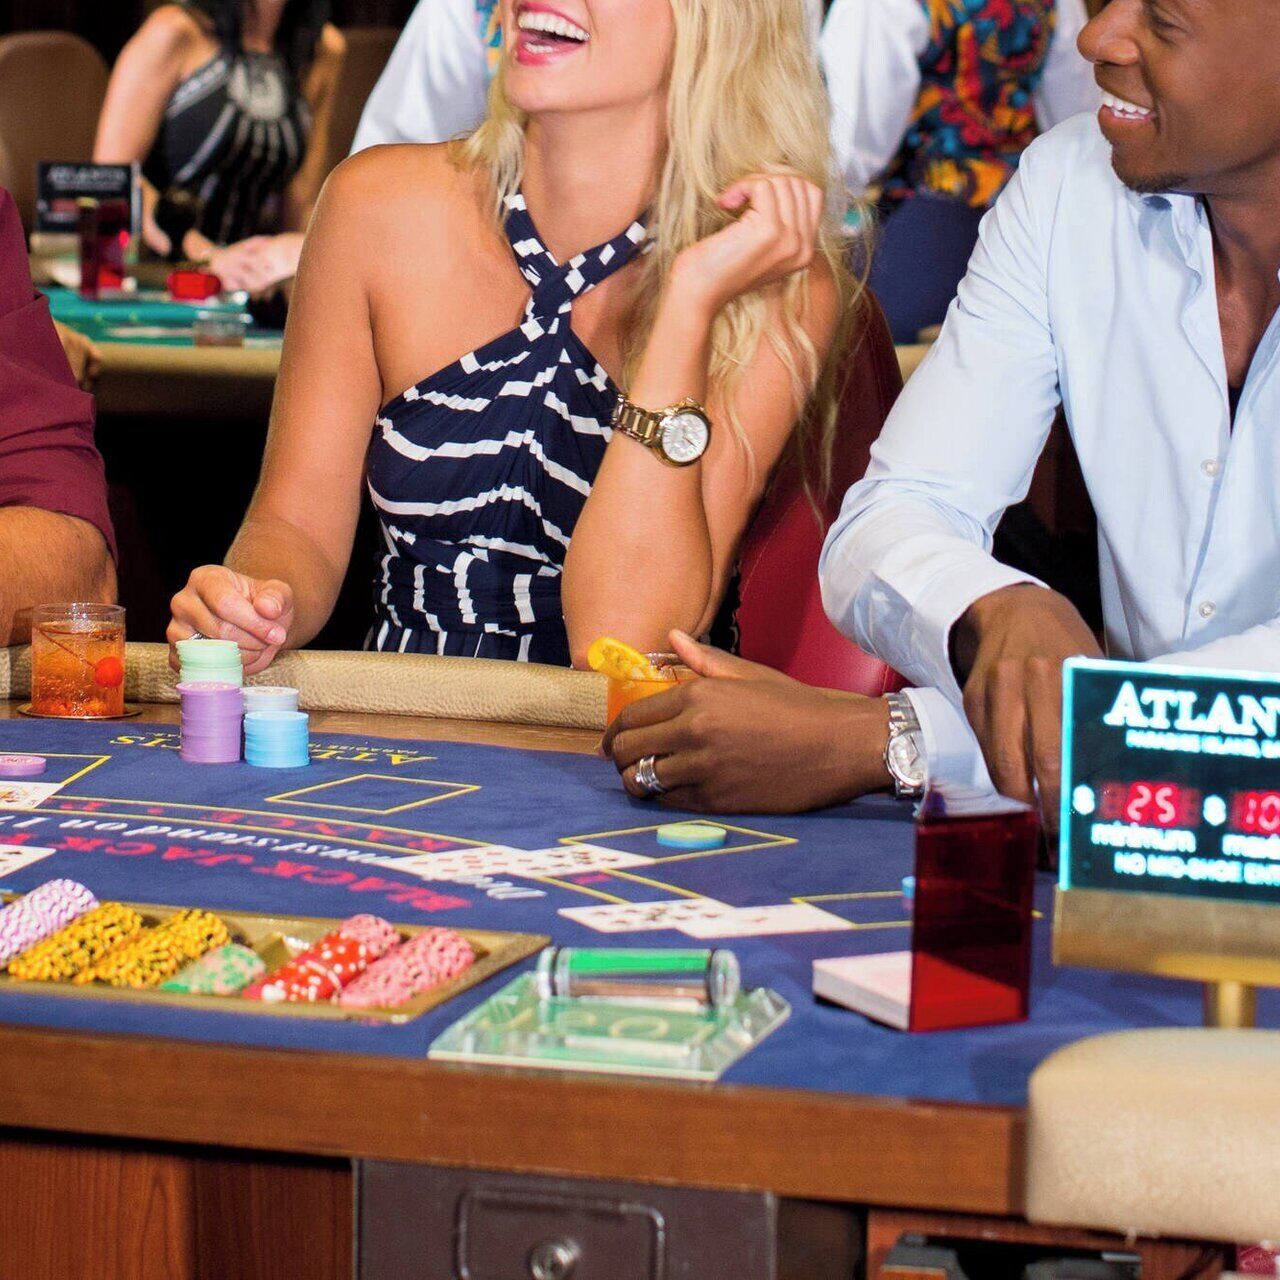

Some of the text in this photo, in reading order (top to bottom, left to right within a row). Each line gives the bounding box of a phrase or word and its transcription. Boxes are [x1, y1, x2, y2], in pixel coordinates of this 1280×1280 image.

[110, 735, 438, 766] ATLTIS
[1126, 783, 1177, 824] 25
[58, 819, 129, 832] on
[122, 824, 280, 848] stand
[48, 834, 255, 867] JACK
[250, 858, 472, 913] BLACK
